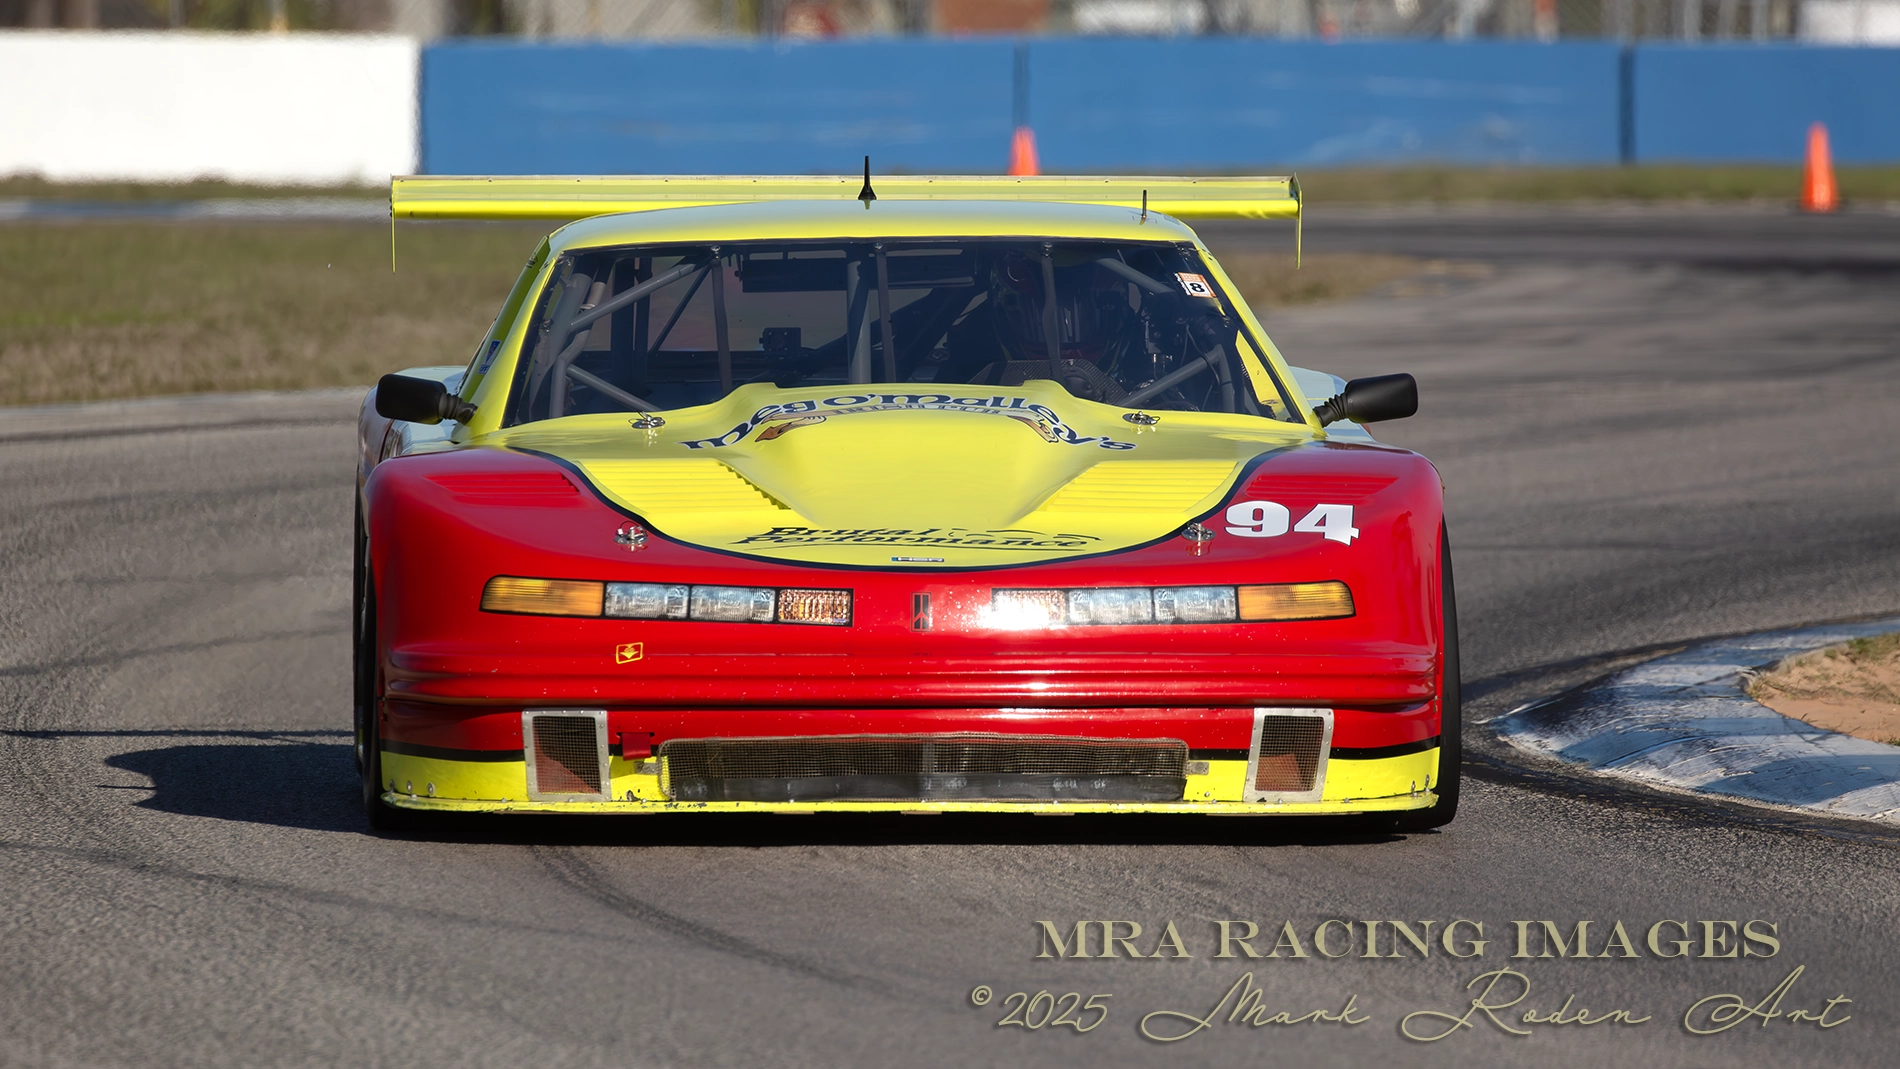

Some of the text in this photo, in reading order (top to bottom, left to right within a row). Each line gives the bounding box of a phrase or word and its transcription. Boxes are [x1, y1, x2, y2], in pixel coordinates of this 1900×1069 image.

[1189, 282, 1205, 293] 8
[1224, 500, 1361, 547] 94
[760, 527, 942, 537] Brutal
[729, 535, 1088, 547] Performance
